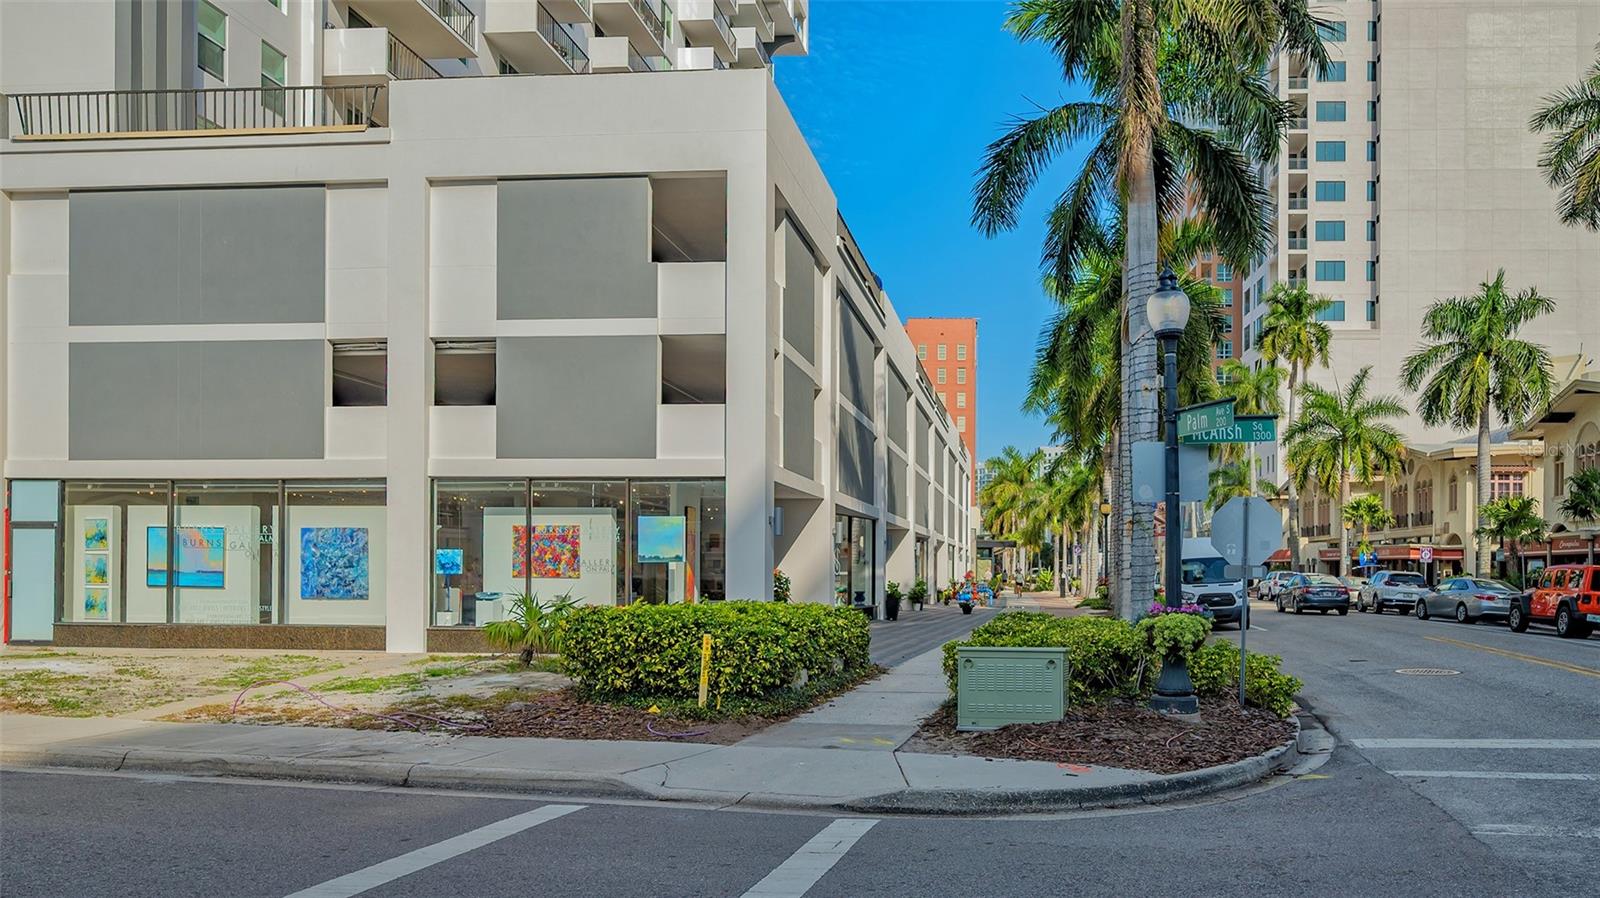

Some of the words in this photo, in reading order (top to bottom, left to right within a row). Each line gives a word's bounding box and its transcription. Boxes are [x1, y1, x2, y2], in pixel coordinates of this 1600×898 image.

[1215, 406, 1225, 416] Ave
[1226, 404, 1230, 415] S
[1186, 413, 1208, 432] Palm
[1215, 416, 1227, 427] 200
[1252, 421, 1263, 432] Sq
[1252, 431, 1272, 441] 1300
[183, 538, 223, 548] BURNS
